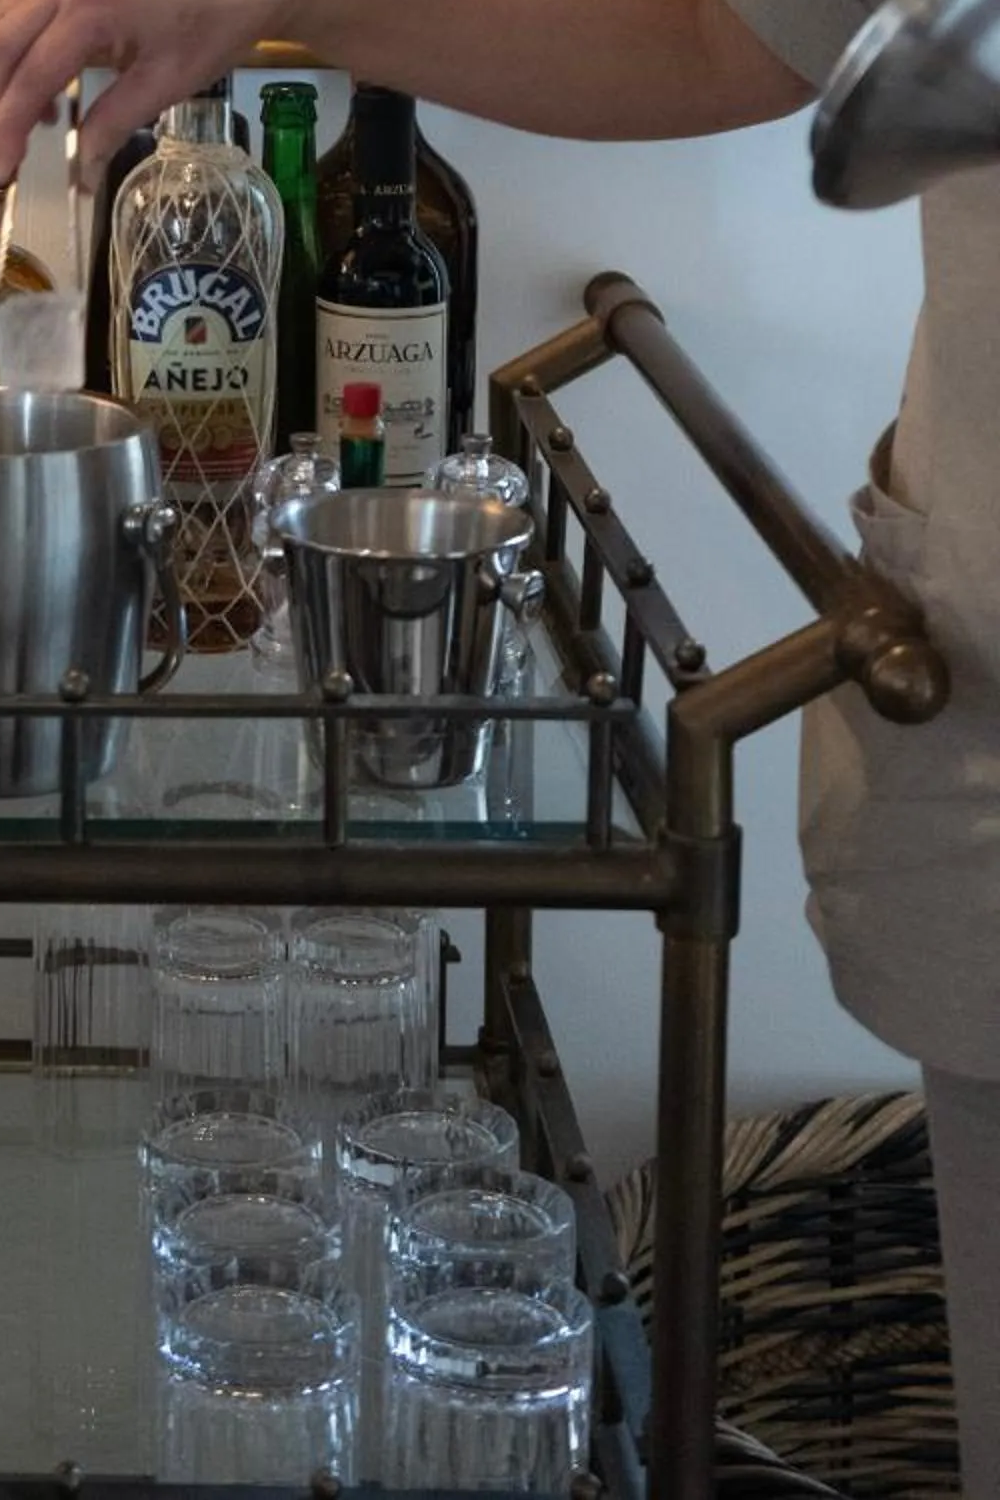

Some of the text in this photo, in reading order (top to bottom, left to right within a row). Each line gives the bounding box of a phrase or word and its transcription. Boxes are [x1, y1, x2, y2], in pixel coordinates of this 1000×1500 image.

[132, 268, 263, 340] BRUGAL
[323, 336, 435, 364] ARZUAGA
[143, 361, 249, 392] AÑEJO
